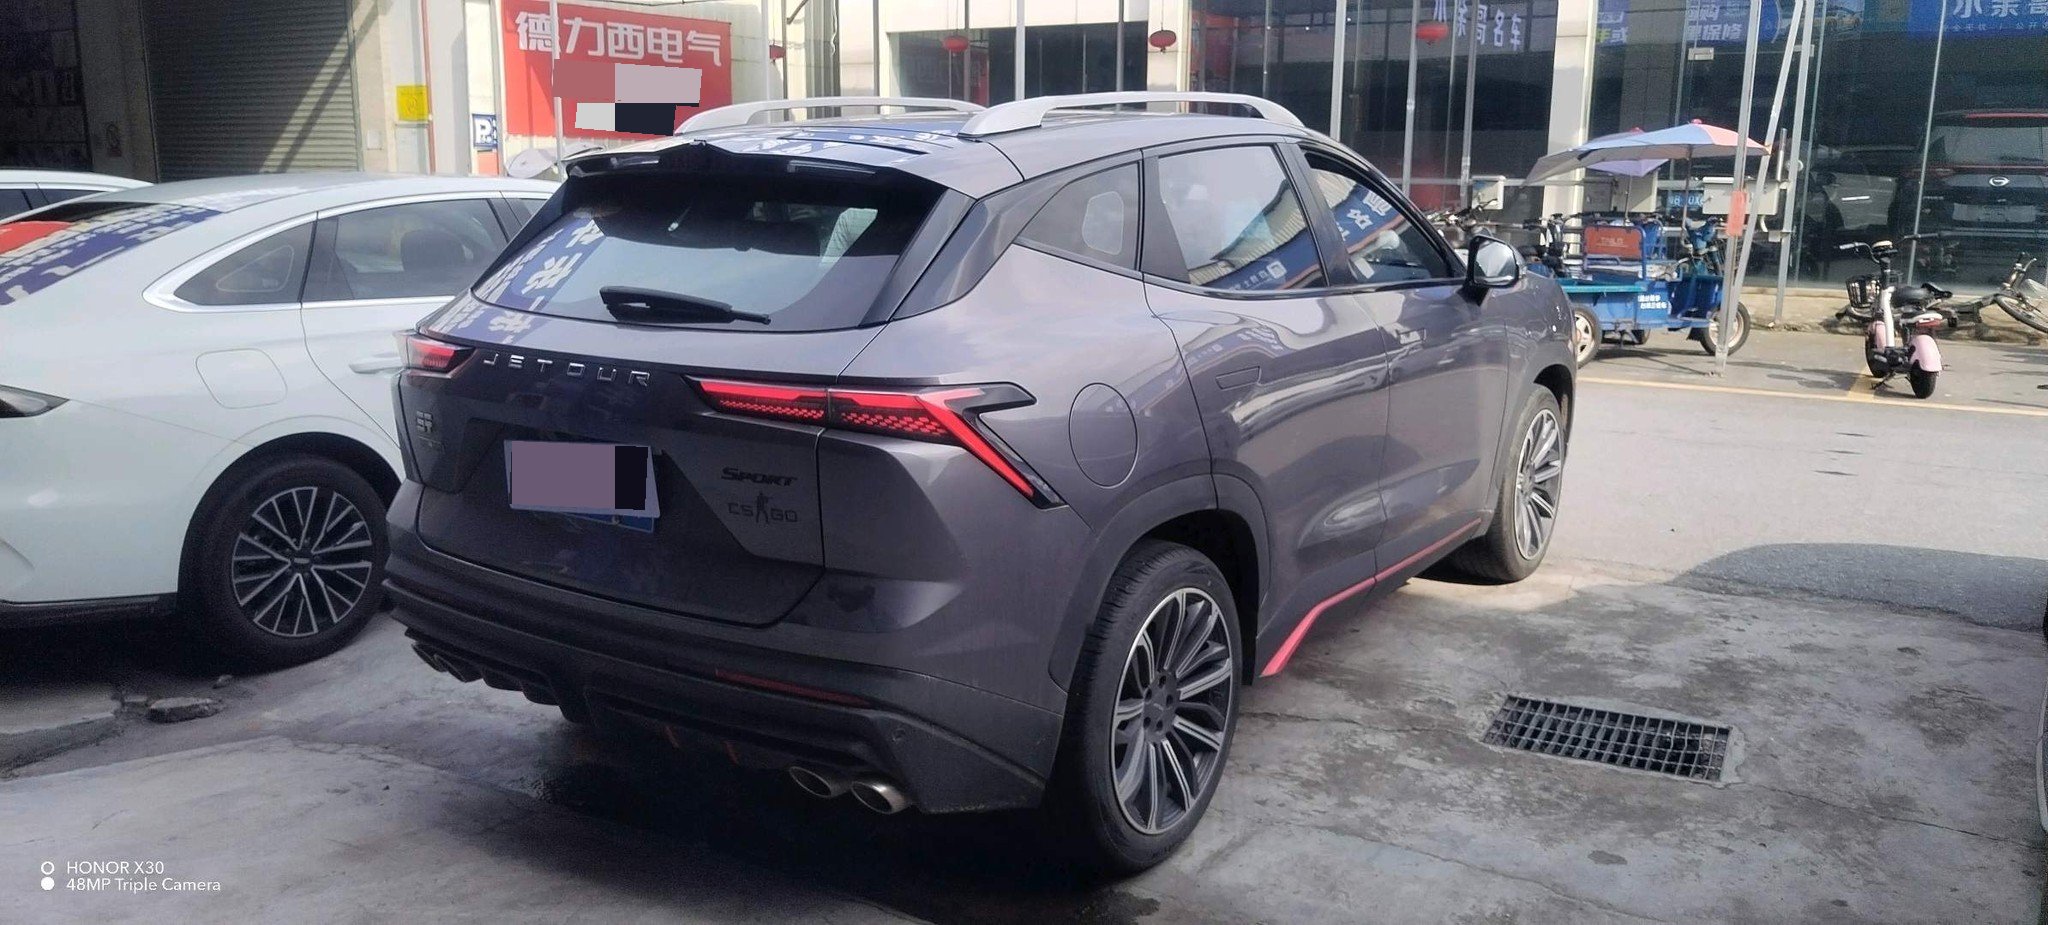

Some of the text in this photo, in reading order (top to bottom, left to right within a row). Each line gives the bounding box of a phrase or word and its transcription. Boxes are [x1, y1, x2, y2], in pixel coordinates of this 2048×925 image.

[515, 11, 722, 67] 德力西电气
[483, 353, 651, 387] JETOUR
[721, 467, 798, 486] SPORT
